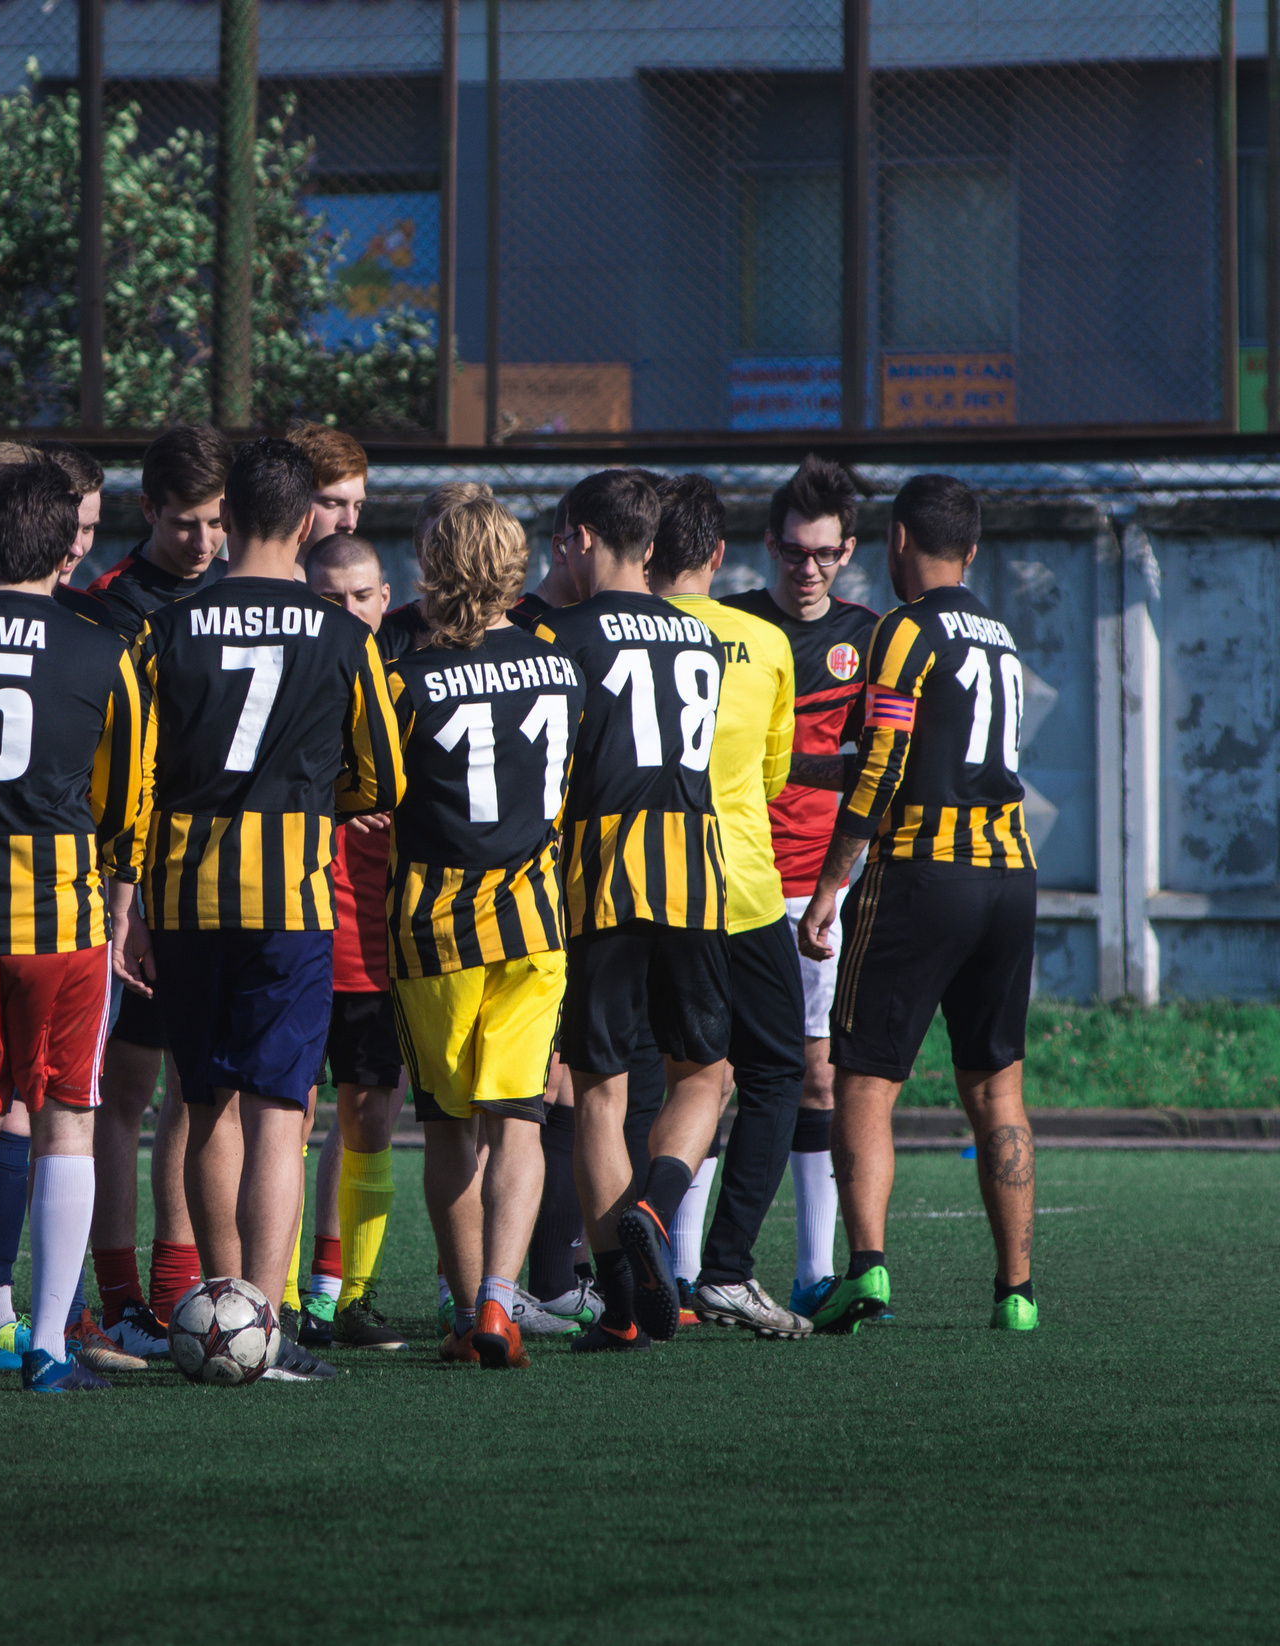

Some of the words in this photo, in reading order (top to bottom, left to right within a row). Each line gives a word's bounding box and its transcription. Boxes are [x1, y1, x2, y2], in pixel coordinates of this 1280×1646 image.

[190, 606, 325, 637] MASLOV
[424, 655, 579, 702] SHVACHICH
[221, 645, 285, 772] 7
[433, 694, 569, 822] 11
[598, 648, 720, 772] 18
[954, 646, 1024, 773] 10
